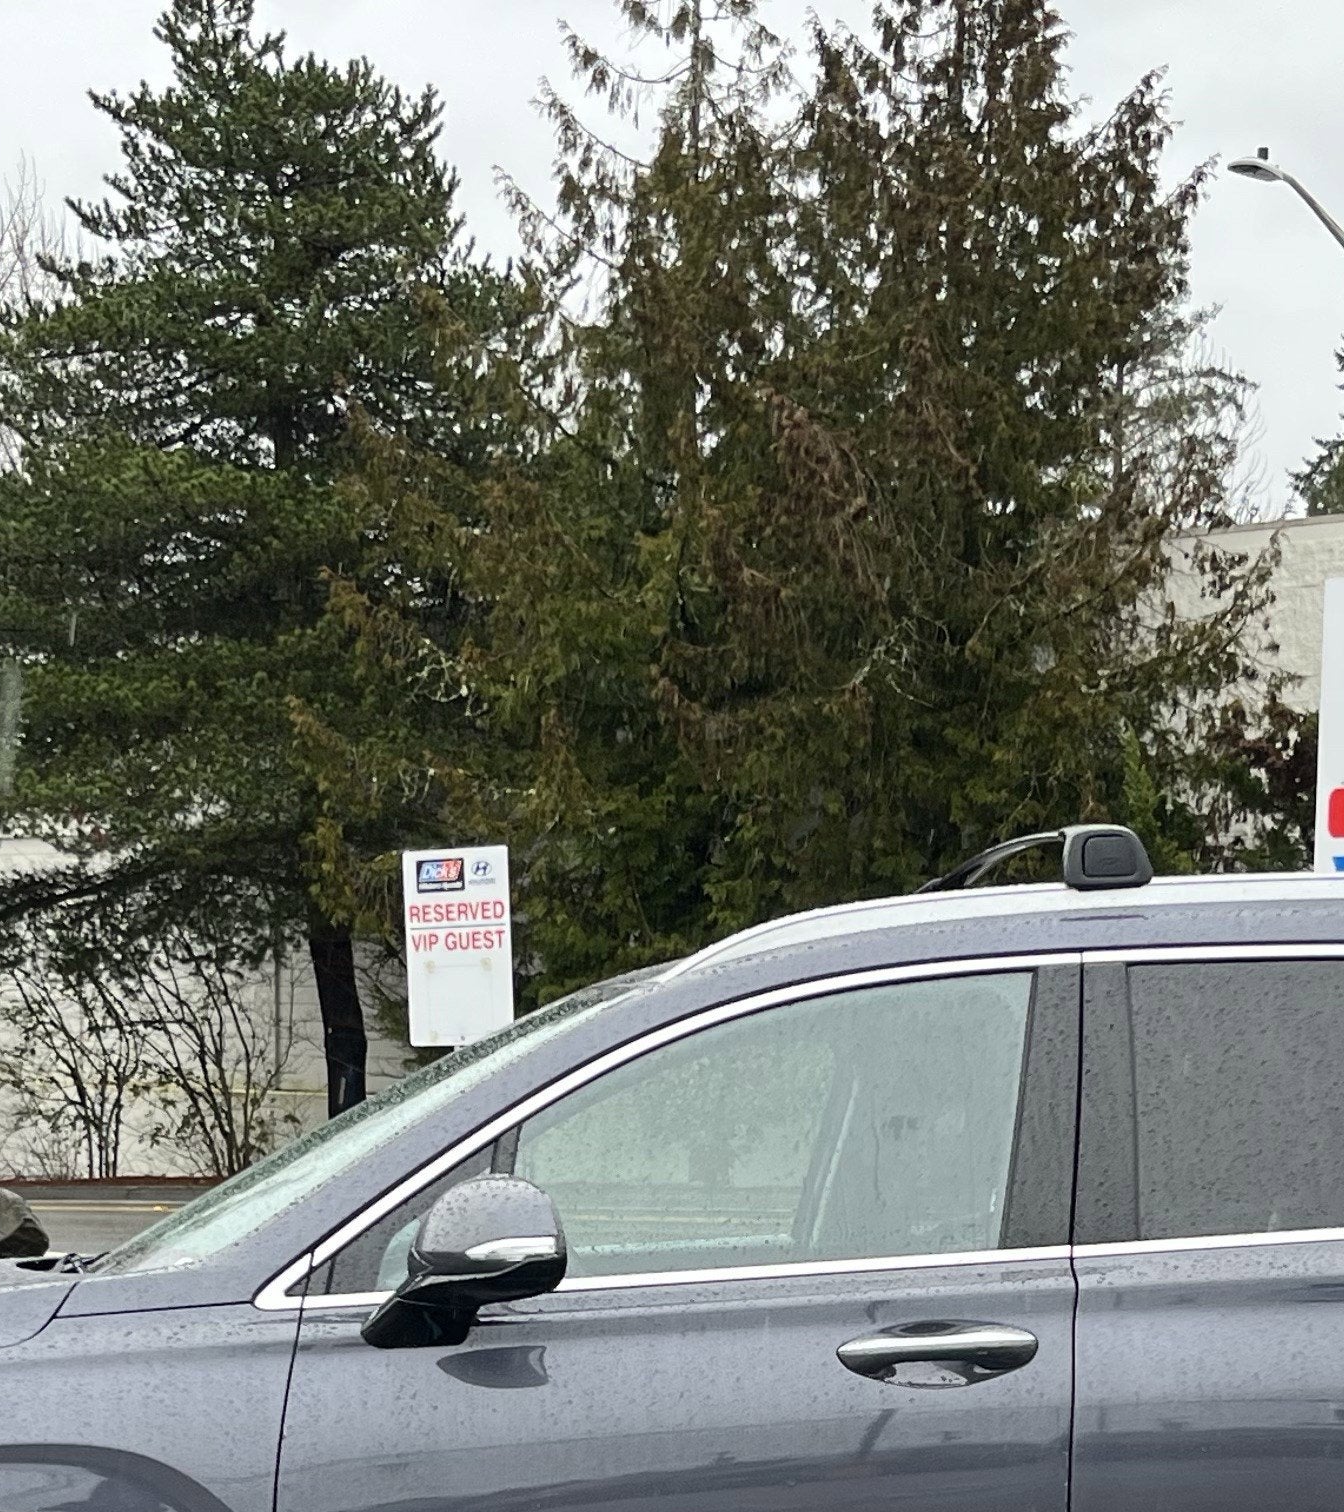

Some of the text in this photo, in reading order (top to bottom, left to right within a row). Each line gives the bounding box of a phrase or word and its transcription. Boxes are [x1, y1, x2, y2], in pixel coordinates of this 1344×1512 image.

[408, 901, 505, 923] RESERVED
[411, 929, 506, 952] VIP GUEST
